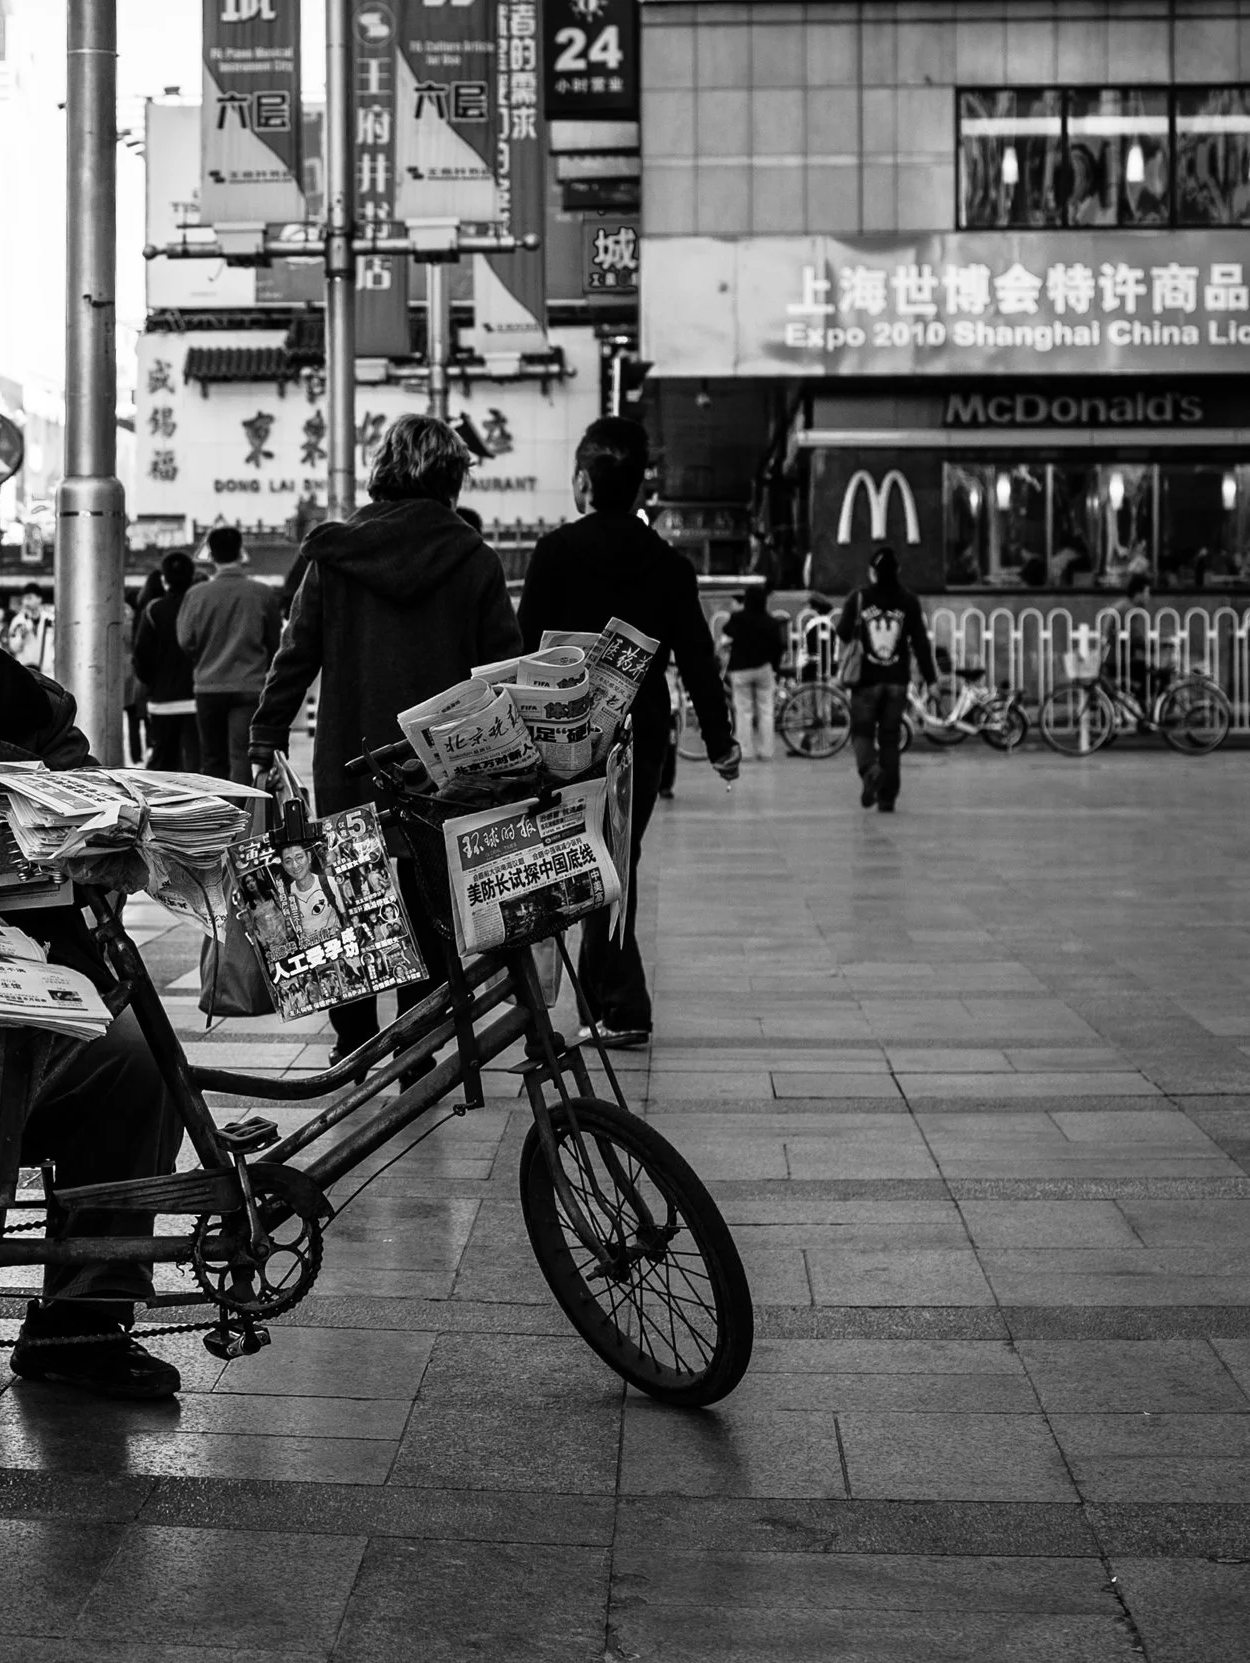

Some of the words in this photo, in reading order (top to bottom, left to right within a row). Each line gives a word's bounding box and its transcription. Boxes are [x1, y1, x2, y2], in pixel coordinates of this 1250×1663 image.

[554, 24, 624, 72] 24
[414, 80, 488, 123] 六层
[554, 76, 624, 94] 小时营业
[216, 91, 290, 133] 六层
[355, 57, 393, 290] 王府井书店
[592, 228, 637, 270] 城
[785, 262, 1249, 316] 上海世博会特许商品
[784, 322, 867, 351] Expo
[872, 320, 947, 347] 2010
[953, 319, 1101, 352] Shanghai
[1107, 319, 1200, 346] China
[947, 392, 1204, 422] McDonald's
[214, 478, 261, 493] DONG
[269, 479, 296, 493] LAI
[533, 680, 550, 688] FIFA
[345, 811, 368, 838] 5
[462, 814, 537, 859] 环球时报
[466, 843, 597, 907] 美防长试探中国底线
[273, 937, 343, 985] 人工受孕
